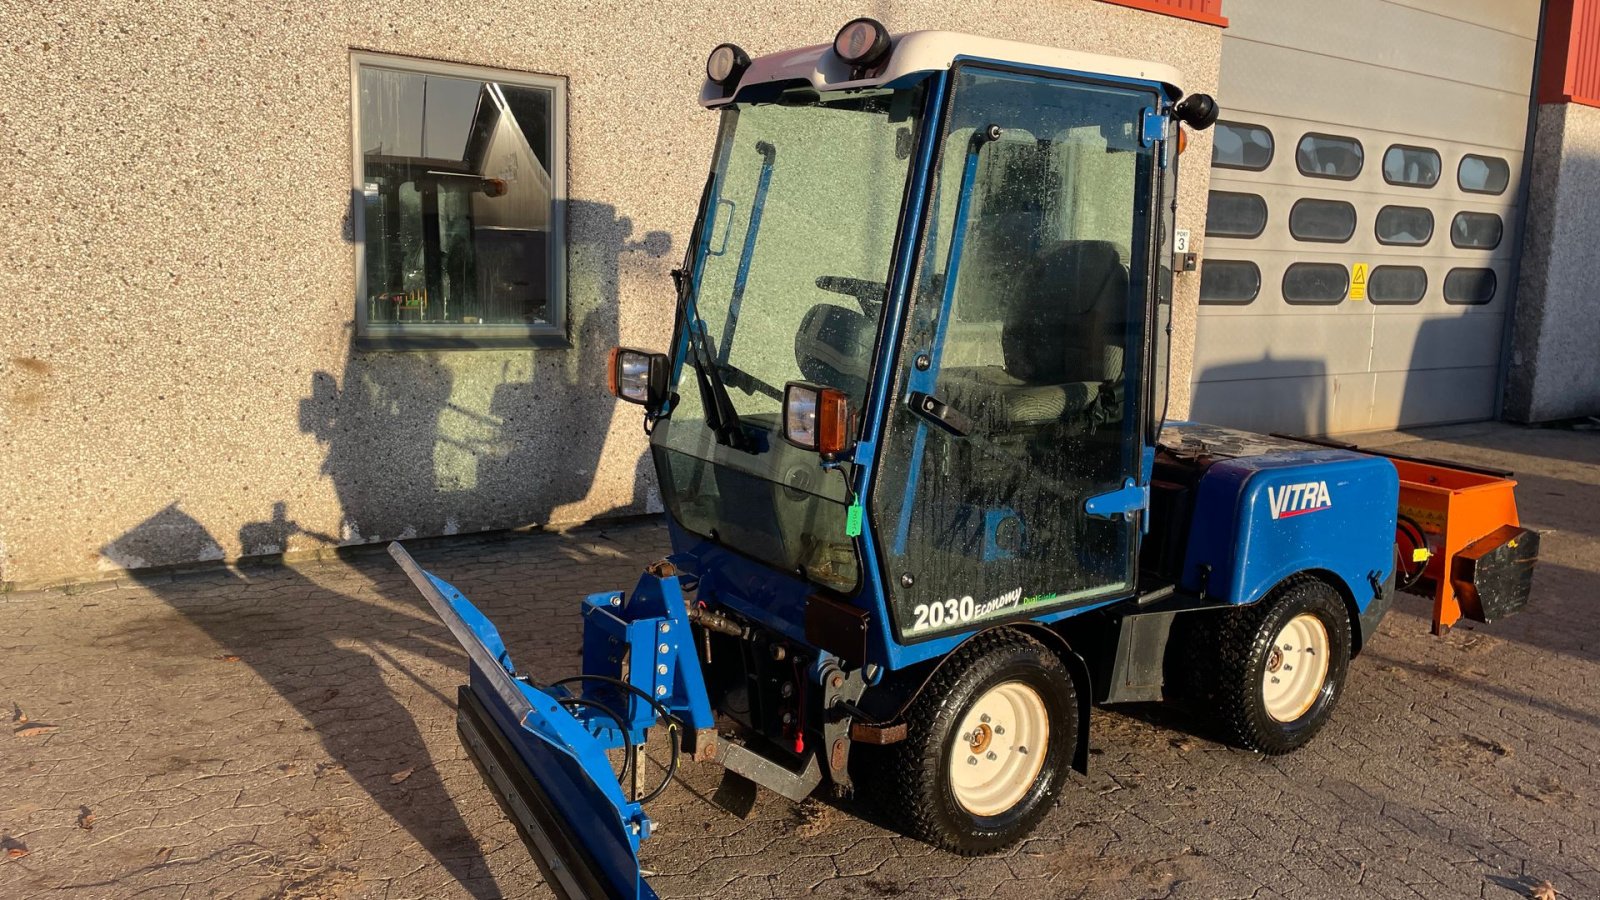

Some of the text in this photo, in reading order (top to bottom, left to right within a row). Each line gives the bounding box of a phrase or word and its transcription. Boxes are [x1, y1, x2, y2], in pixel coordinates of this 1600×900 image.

[1178, 238, 1185, 251] 3
[1268, 481, 1332, 520] VITRA
[913, 596, 974, 631] 2030
[974, 586, 1022, 619] Economy
